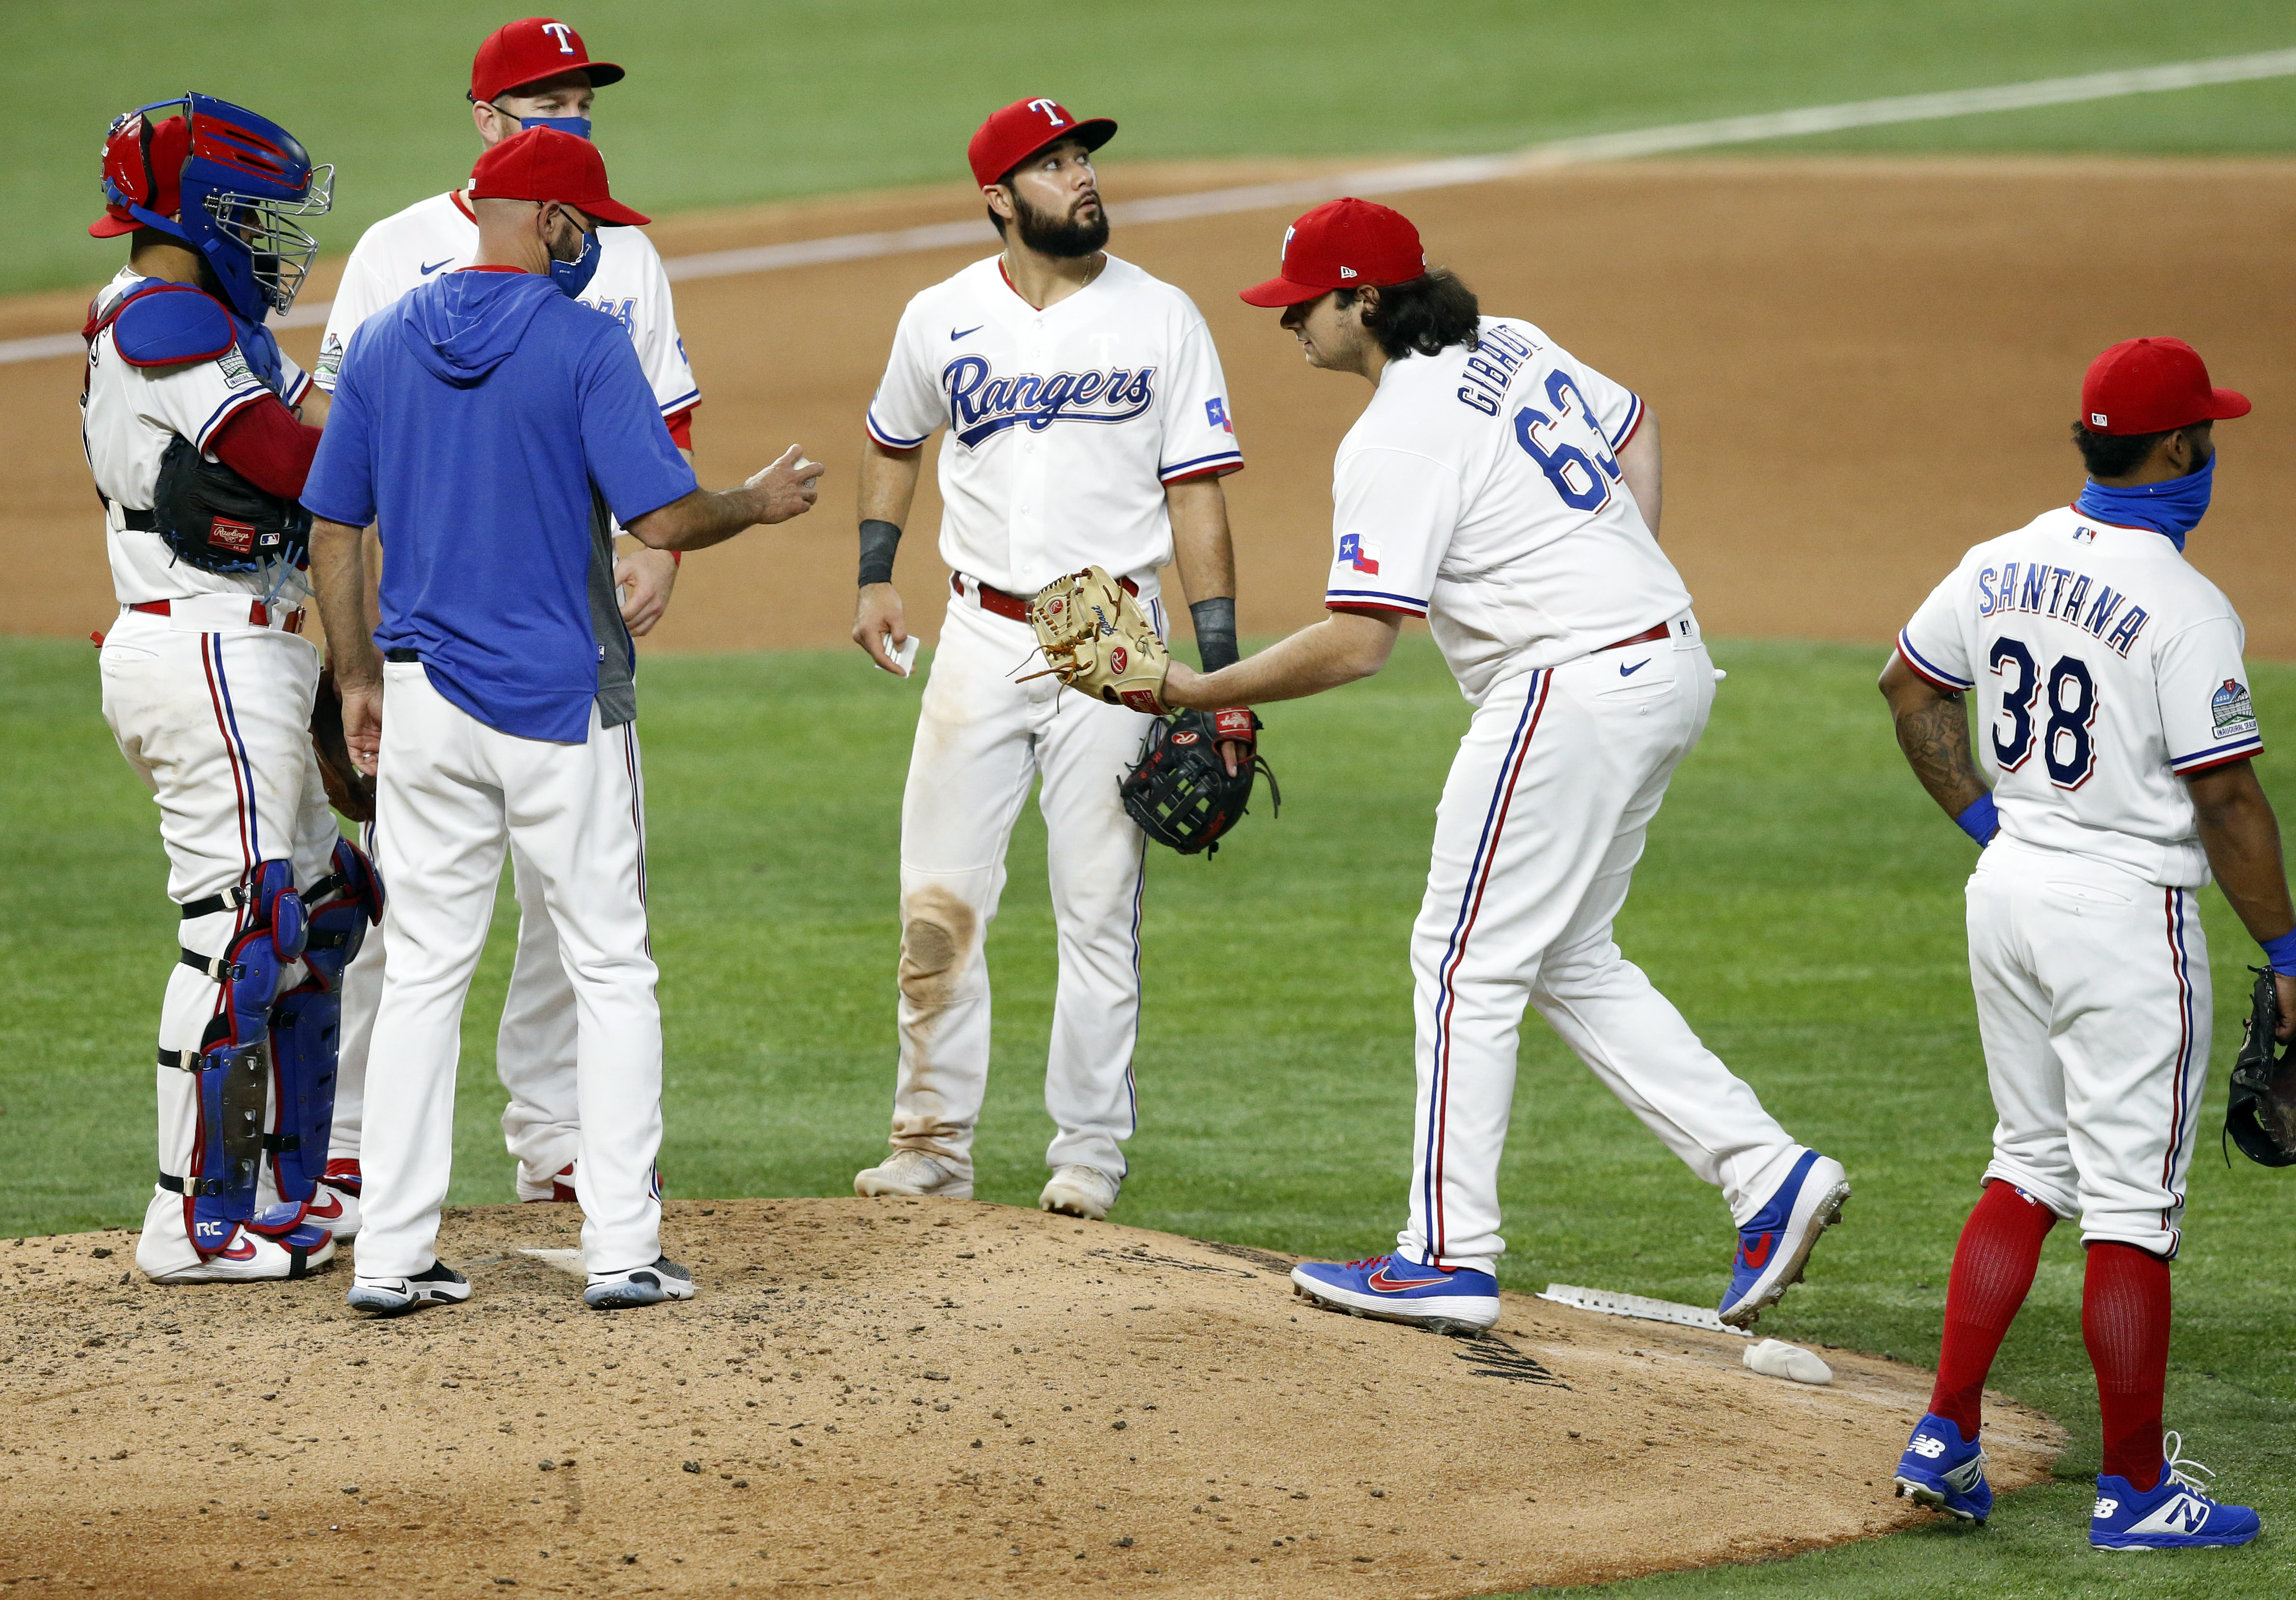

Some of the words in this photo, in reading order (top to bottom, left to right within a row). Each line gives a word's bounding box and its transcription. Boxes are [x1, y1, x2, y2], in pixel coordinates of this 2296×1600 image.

[542, 23, 574, 55] T
[1027, 99, 1065, 127] T
[941, 354, 1157, 452] Rangers
[1513, 369, 1623, 515] 63
[214, 526, 250, 543] Rawlings
[1978, 562, 2150, 659] SANTANA
[2216, 694, 2230, 702] 2020
[1989, 636, 2099, 792] 38
[2216, 724, 2244, 737] INAUGURAL
[196, 1221, 223, 1236] RC
